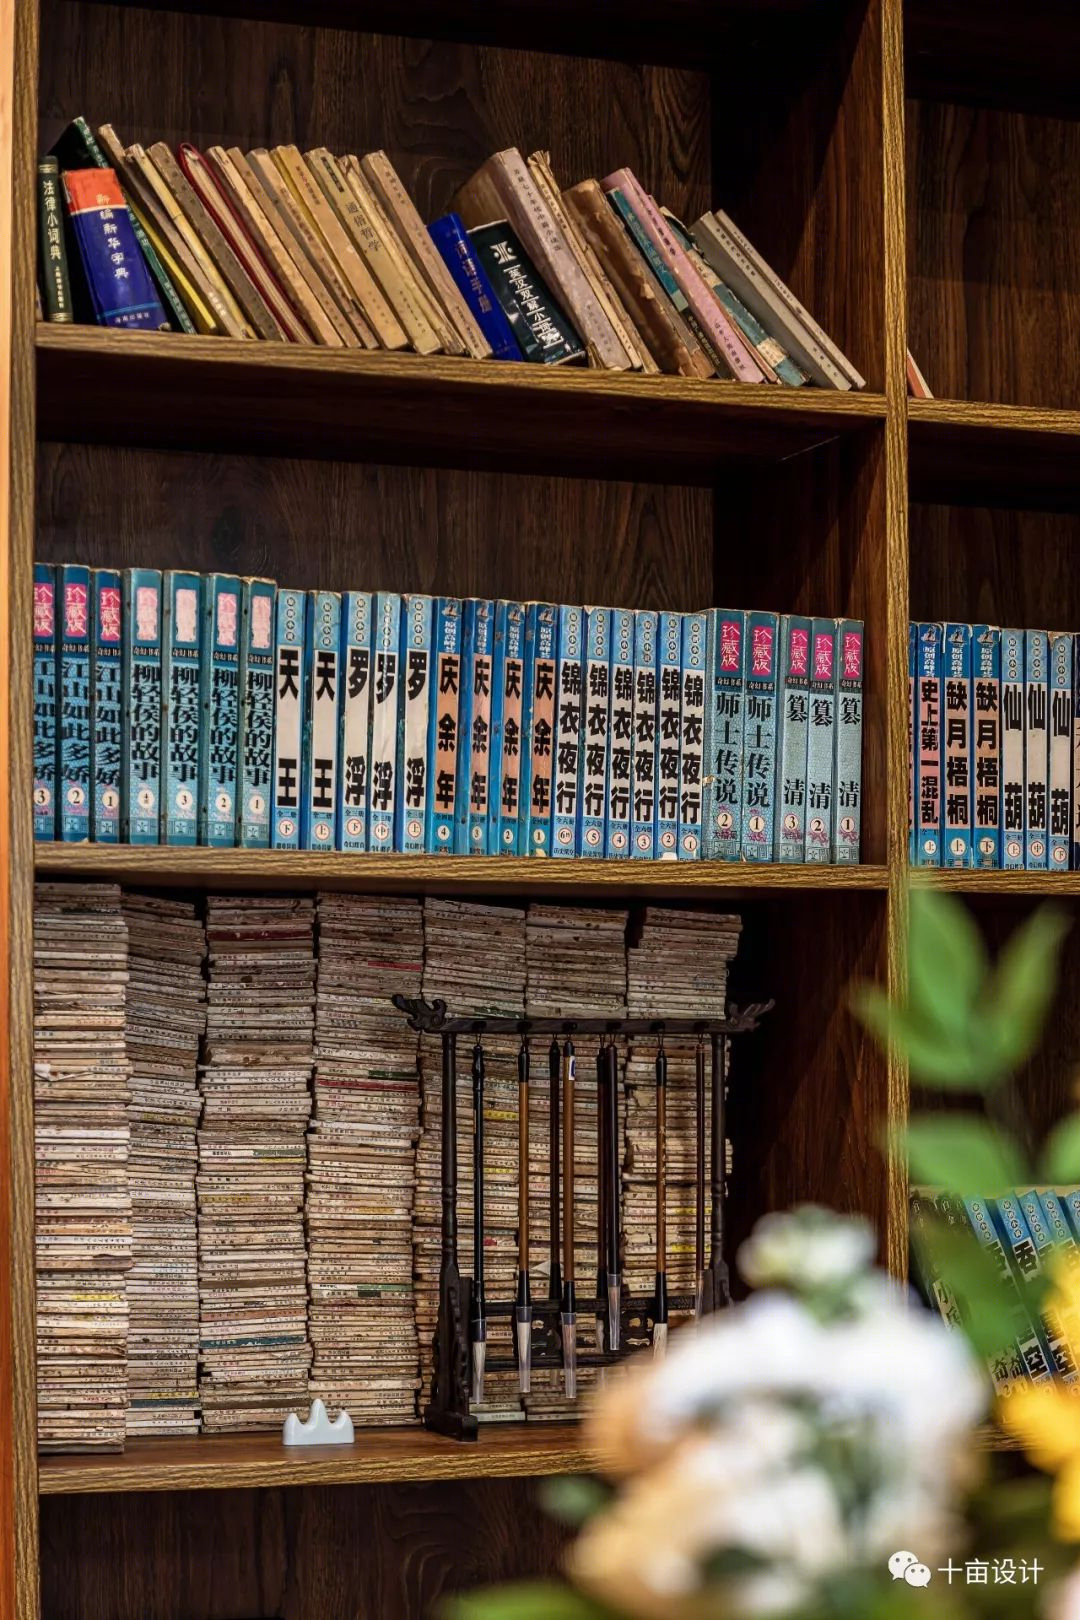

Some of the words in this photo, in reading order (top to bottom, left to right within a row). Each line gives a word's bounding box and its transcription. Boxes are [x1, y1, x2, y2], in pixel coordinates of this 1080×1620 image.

[43, 180, 61, 260] 法律小词典
[96, 193, 129, 278] 新编新华字典
[346, 202, 382, 252] 通俗哲学
[34, 586, 54, 634] 珍藏版
[65, 586, 87, 634] 珍藏版
[100, 591, 121, 639] 珍藏版
[721, 625, 741, 669] 珍藏版
[752, 629, 772, 674] 珍藏版
[791, 632, 808, 674] 珍藏版
[815, 636, 833, 677] 珍藏版
[843, 635, 861, 675] 珍藏版
[62, 661, 90, 783] 江山如此多娇
[95, 664, 121, 786] 江山如此多娇
[131, 664, 160, 781] 柳轻侯的故事
[171, 665, 200, 781] 柳轻侯的故事
[211, 670, 238, 785] 柳轻侯的故事
[245, 671, 273, 787] 柳轻侯的故事
[277, 649, 300, 807] 天王
[313, 651, 336, 810] 天王
[345, 650, 370, 807] 罗浮
[373, 653, 397, 811] 罗浮
[406, 650, 428, 808] 罗浮
[437, 658, 459, 809] 庆余年
[470, 659, 490, 815] 庆余年
[502, 661, 522, 816] 庆余年
[532, 658, 554, 817] 庆余年
[556, 662, 581, 815] 锦衣夜行
[585, 663, 608, 817] 锦衣夜行
[610, 667, 632, 820] 锦衣夜行
[659, 669, 680, 821] 锦衣夜行
[634, 672, 656, 822] 锦衣夜行
[680, 674, 703, 825] 锦衣夜行
[715, 693, 741, 805] 师士传说
[746, 696, 773, 809] 师士传说
[783, 695, 809, 807] 篡清
[808, 698, 833, 810] 篡清
[838, 697, 862, 807] 篡清
[921, 680, 938, 824] 史上第一混乱
[946, 681, 969, 826] 缺月梧桐
[976, 682, 999, 827] 缺月梧桐
[1003, 684, 1023, 831] 仙葫
[1028, 684, 1047, 830] 仙葫
[1051, 690, 1071, 836] 仙葫
[37, 789, 46, 804] 3
[72, 790, 80, 804] 2
[108, 796, 113, 807] 1
[181, 795, 188, 806] 3
[221, 797, 227, 808] 2
[254, 799, 260, 809] 1
[721, 814, 729, 827] 2
[283, 823, 291, 834] 下
[319, 825, 328, 836] 上
[352, 822, 359, 832] 下
[377, 825, 386, 837] 中
[411, 824, 419, 834] 上
[440, 827, 447, 836] 4
[474, 829, 480, 839] 3
[505, 830, 511, 840] 2
[537, 831, 542, 841] 1
[591, 832, 597, 842] 5
[616, 835, 622, 844] 4
[641, 838, 647, 847] 3
[666, 835, 672, 844] 2
[688, 841, 693, 850] 1
[754, 817, 760, 830] 1
[788, 816, 797, 829] 3
[814, 820, 822, 832] 2
[844, 818, 851, 830] 1
[926, 841, 935, 852] 上
[953, 839, 964, 852] 上
[979, 840, 993, 853] 下
[1010, 845, 1019, 855] 上
[1033, 844, 1042, 854] 中
[1056, 850, 1065, 860] 下
